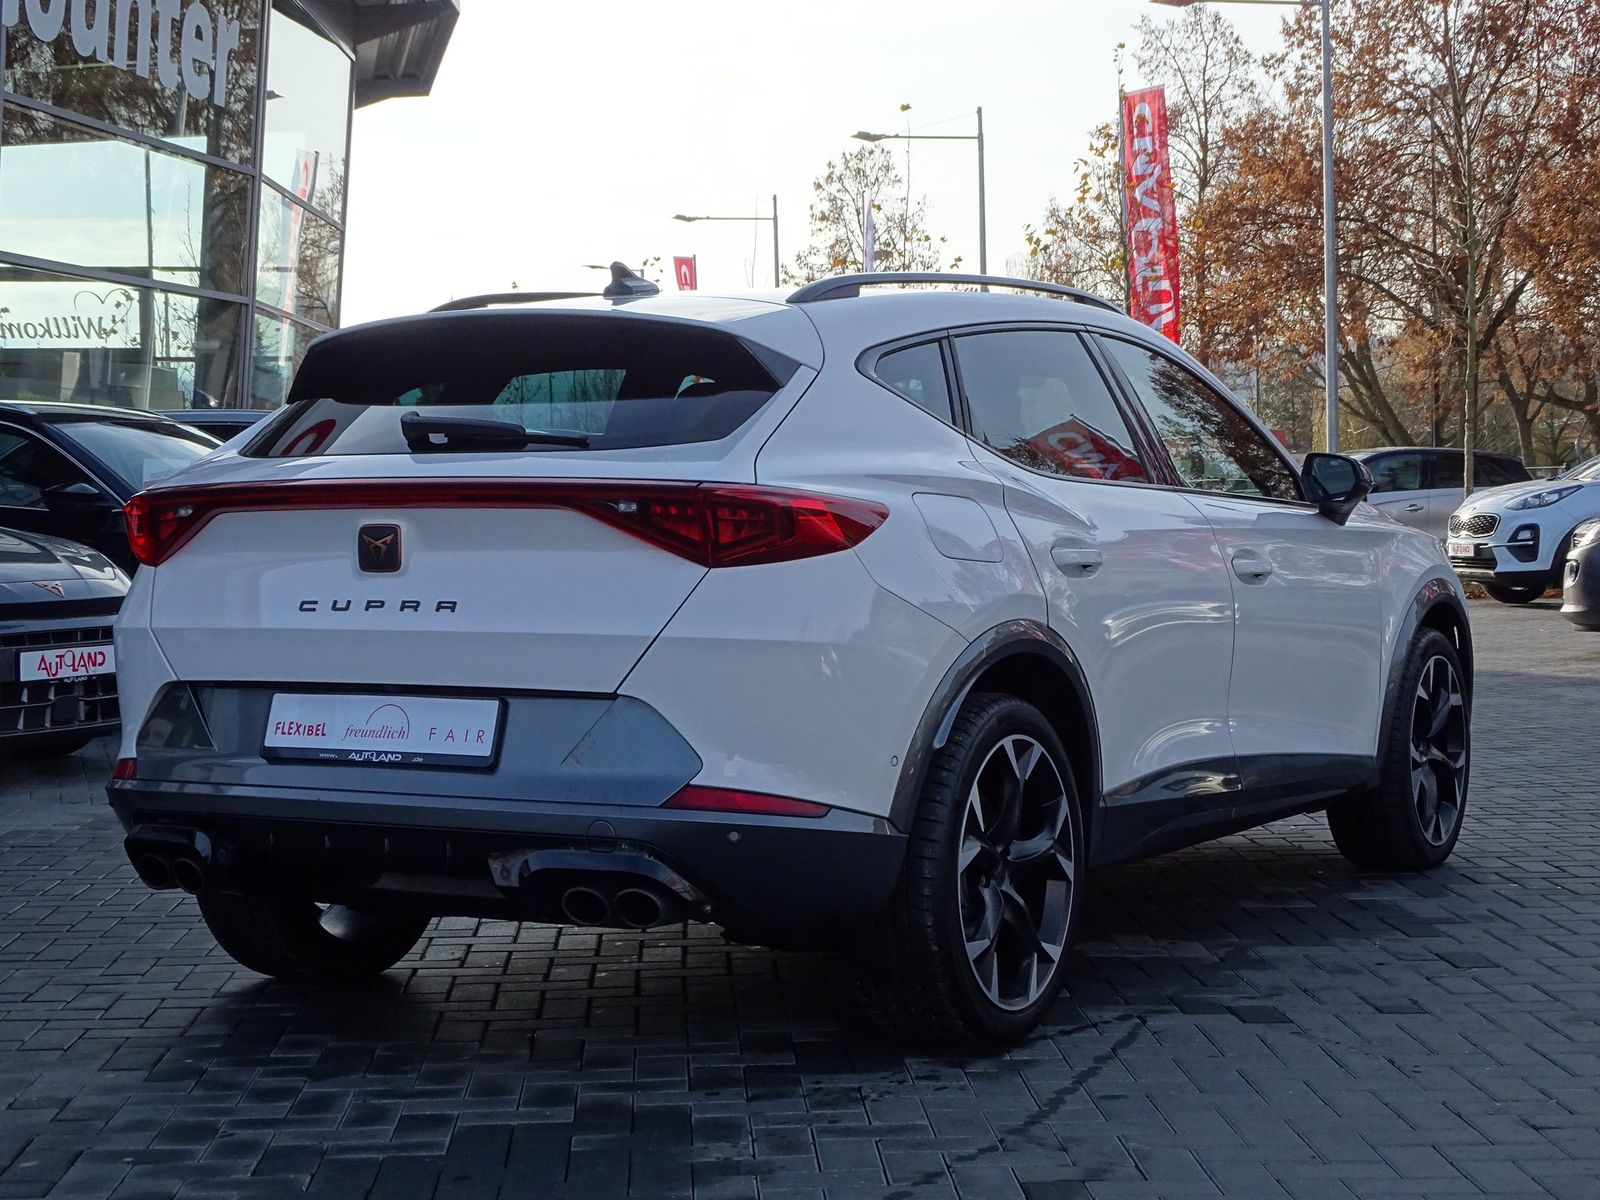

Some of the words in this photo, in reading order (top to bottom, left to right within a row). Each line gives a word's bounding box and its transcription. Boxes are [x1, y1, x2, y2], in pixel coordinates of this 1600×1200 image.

[0, 0, 240, 107] unter
[298, 599, 458, 612] CUPRA
[37, 649, 107, 678] AUTOLAND
[274, 720, 327, 737] FLEXIBEL
[341, 724, 407, 741] freundlich
[428, 726, 486, 744] FAIR
[347, 751, 402, 762] AUTOLAND
